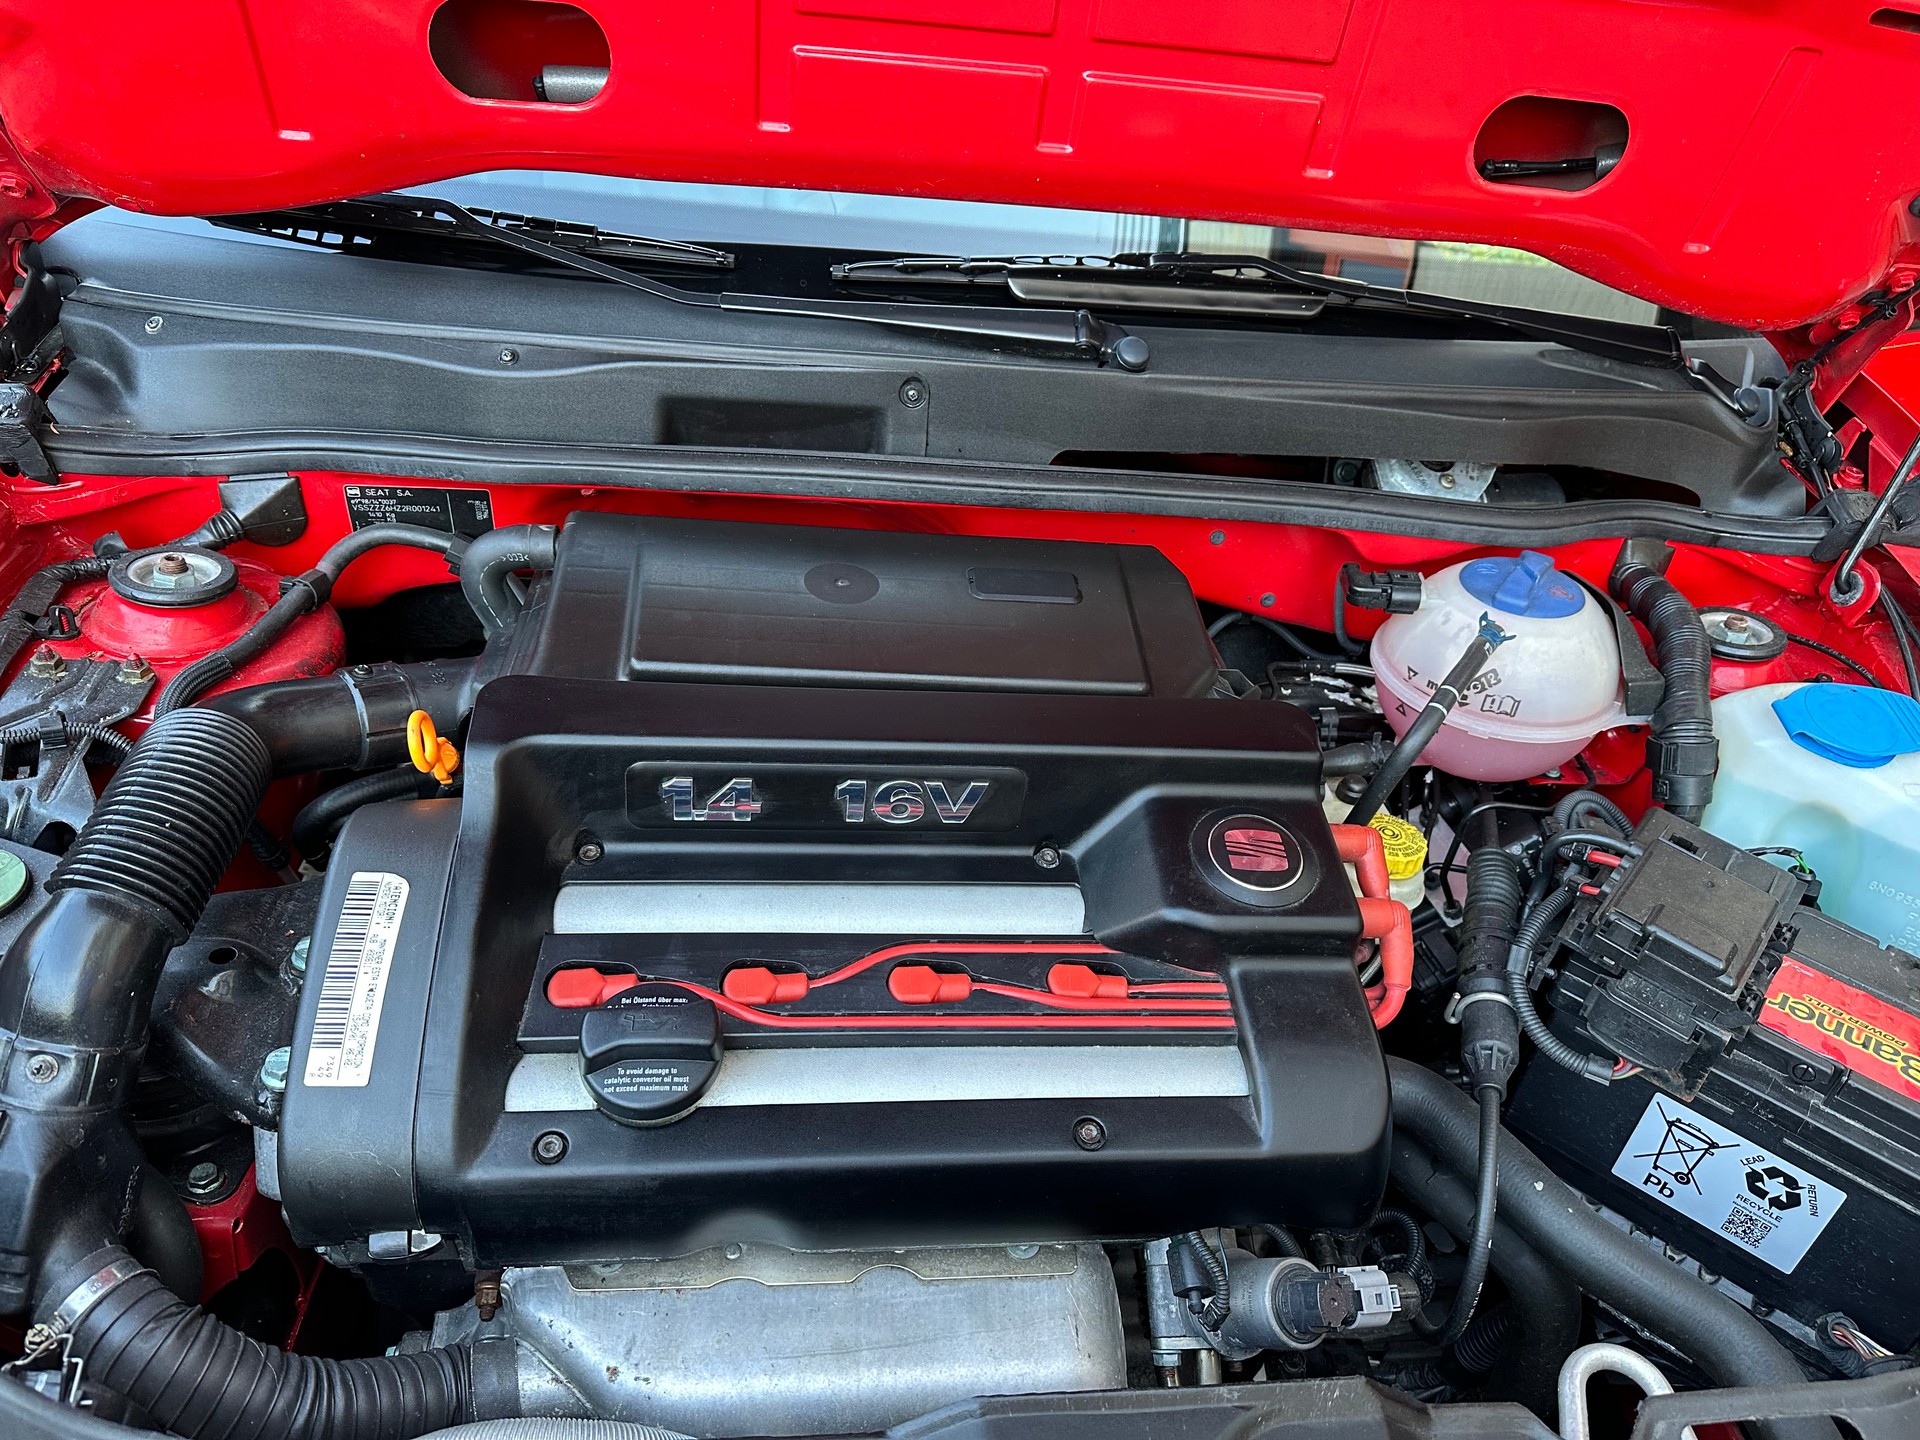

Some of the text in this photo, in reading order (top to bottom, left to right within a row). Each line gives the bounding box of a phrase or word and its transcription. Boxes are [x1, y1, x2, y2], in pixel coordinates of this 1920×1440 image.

[365, 488, 414, 497] SEAT S.A.
[352, 504, 441, 513] VSSZZZ6HZ2R001241
[661, 776, 991, 825] 1.4 16V
[362, 983, 378, 1010] ETQUETA
[1804, 994, 1908, 1048] POWER BULL
[1767, 993, 1920, 1085] Banner
[315, 1066, 325, 1077] 49
[323, 1055, 336, 1077] 7349
[617, 1067, 625, 1075] To
[626, 1067, 643, 1075] avoid
[644, 1067, 670, 1075] damage
[604, 1076, 631, 1085] catalytic
[615, 1084, 638, 1092] exceed
[1739, 1154, 1765, 1167] LEAD
[1642, 1172, 1675, 1199] Pb
[1735, 1193, 1783, 1223] RECYCLE
[1807, 1183, 1819, 1217] RETURN
